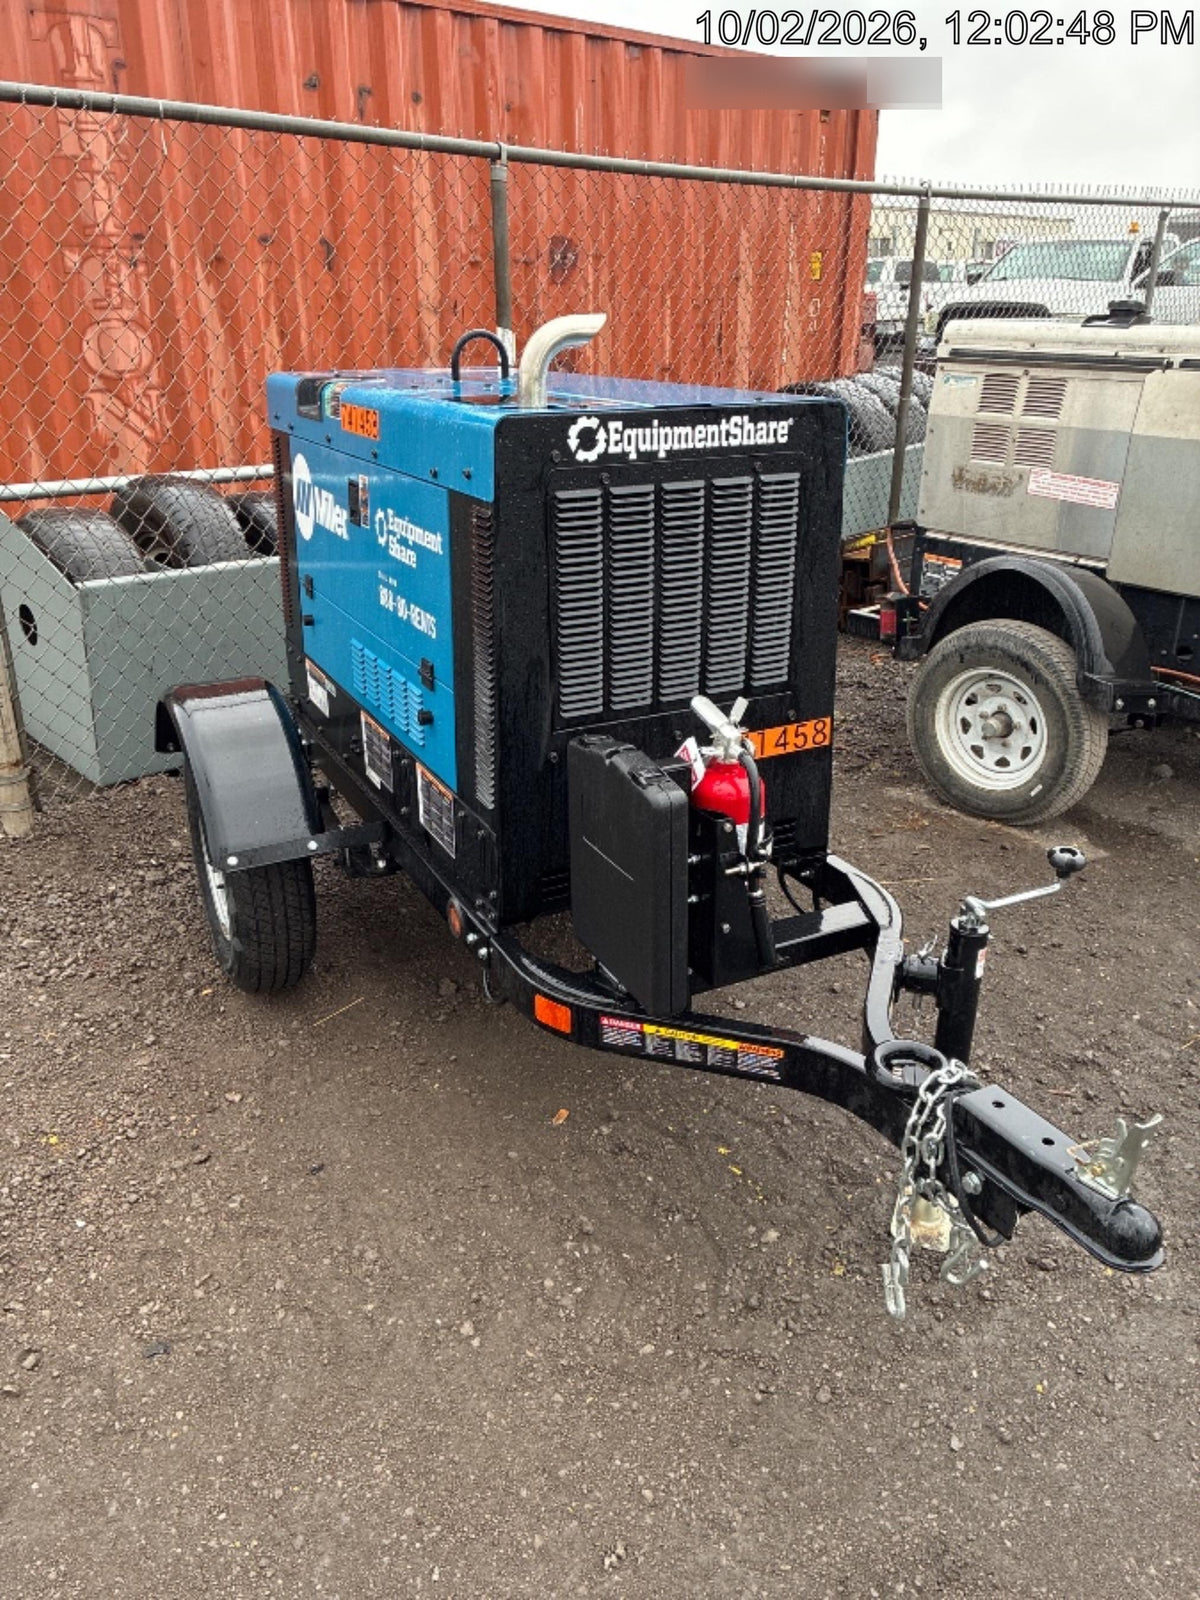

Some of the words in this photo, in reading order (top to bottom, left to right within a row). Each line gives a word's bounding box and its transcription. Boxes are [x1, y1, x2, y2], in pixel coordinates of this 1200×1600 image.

[314, 485, 350, 541] Miller
[387, 508, 444, 555] Equipment
[388, 534, 417, 569] Share
